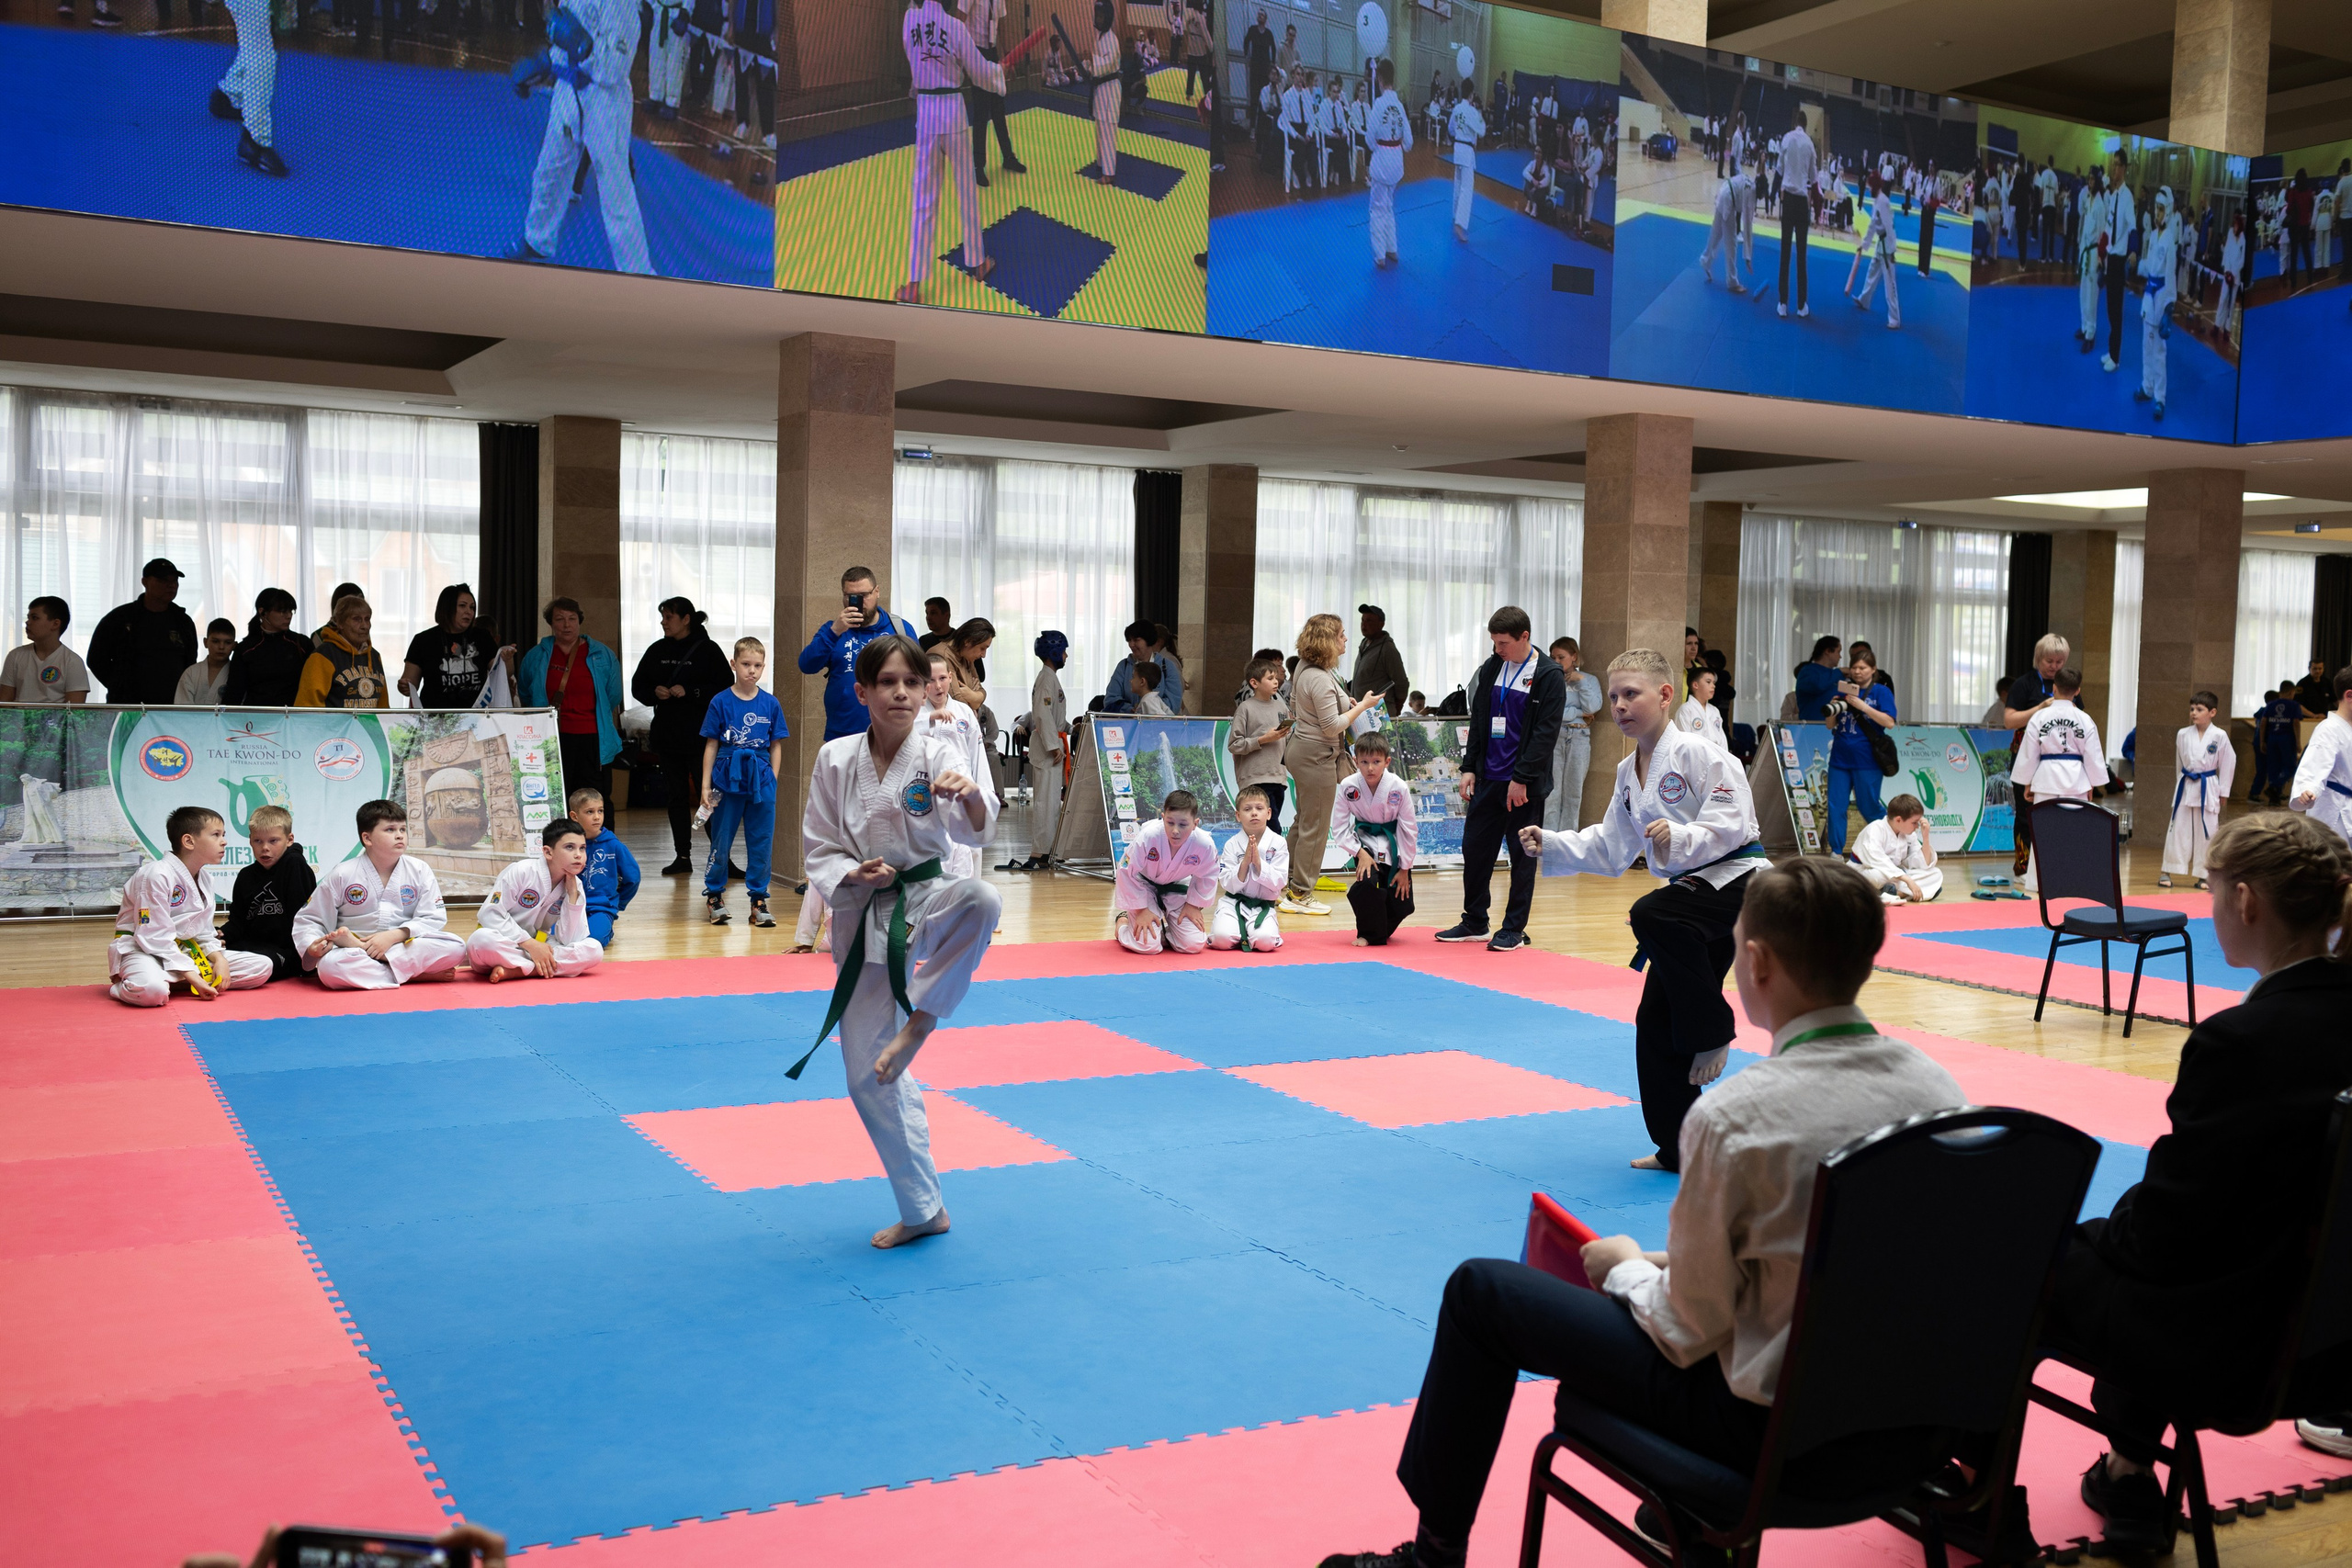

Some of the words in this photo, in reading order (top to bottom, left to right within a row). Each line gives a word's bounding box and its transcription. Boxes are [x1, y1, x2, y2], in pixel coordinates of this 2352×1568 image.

[1363, 15, 1369, 27] 3
[441, 673, 481, 687] NOPE
[207, 749, 230, 759] TAE
[234, 750, 301, 761] KWON-DO
